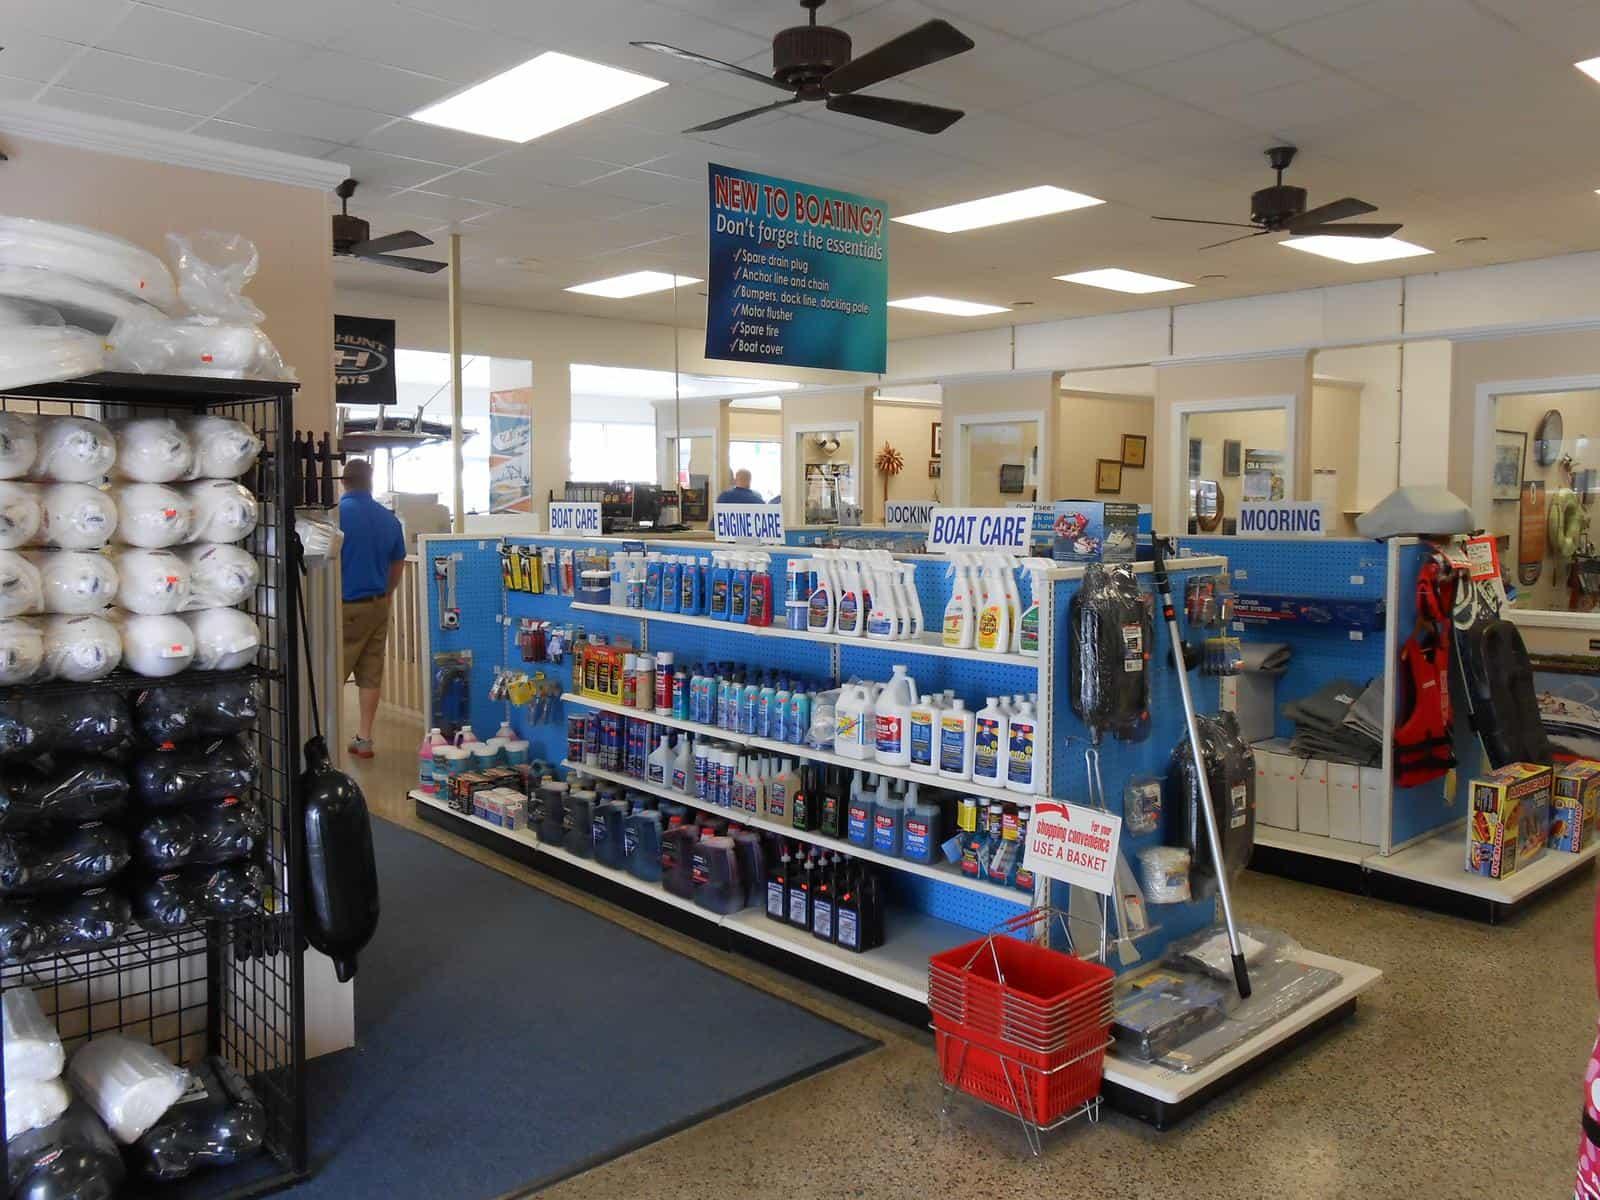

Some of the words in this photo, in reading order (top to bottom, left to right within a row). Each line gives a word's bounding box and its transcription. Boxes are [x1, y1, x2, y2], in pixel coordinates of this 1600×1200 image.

[715, 175, 759, 215] NEW
[763, 185, 790, 220] TO
[795, 192, 883, 237] BOATING?
[717, 213, 754, 238] Don't
[758, 220, 798, 249] forget
[803, 229, 823, 250] the
[826, 237, 882, 260] essentials
[742, 249, 766, 264] Spare
[768, 256, 788, 268] drain
[791, 258, 808, 273] plug
[742, 268, 772, 281] Anchor
[774, 273, 788, 285] line
[790, 276, 806, 288] and
[808, 278, 829, 291] chain
[741, 304, 765, 317] Motor
[767, 307, 793, 320] flusher
[781, 291, 801, 304] dock
[821, 298, 850, 314] docking
[852, 303, 869, 315] pole
[740, 322, 764, 336] Spare
[766, 325, 779, 337] tire
[739, 340, 758, 353] Boat
[760, 344, 784, 355] cover
[551, 508, 573, 529] BOAT
[575, 508, 598, 530] CARE
[717, 512, 752, 538] ENGINE
[754, 513, 781, 539] CARE
[933, 515, 977, 545] BOAT
[980, 516, 1026, 547] CARE
[1241, 509, 1320, 531] MOORING
[1036, 819, 1068, 844] shopping
[1068, 829, 1110, 853] convenience
[1033, 840, 1053, 857] USE
[1056, 846, 1063, 860] A
[1066, 848, 1108, 873] BASKET
